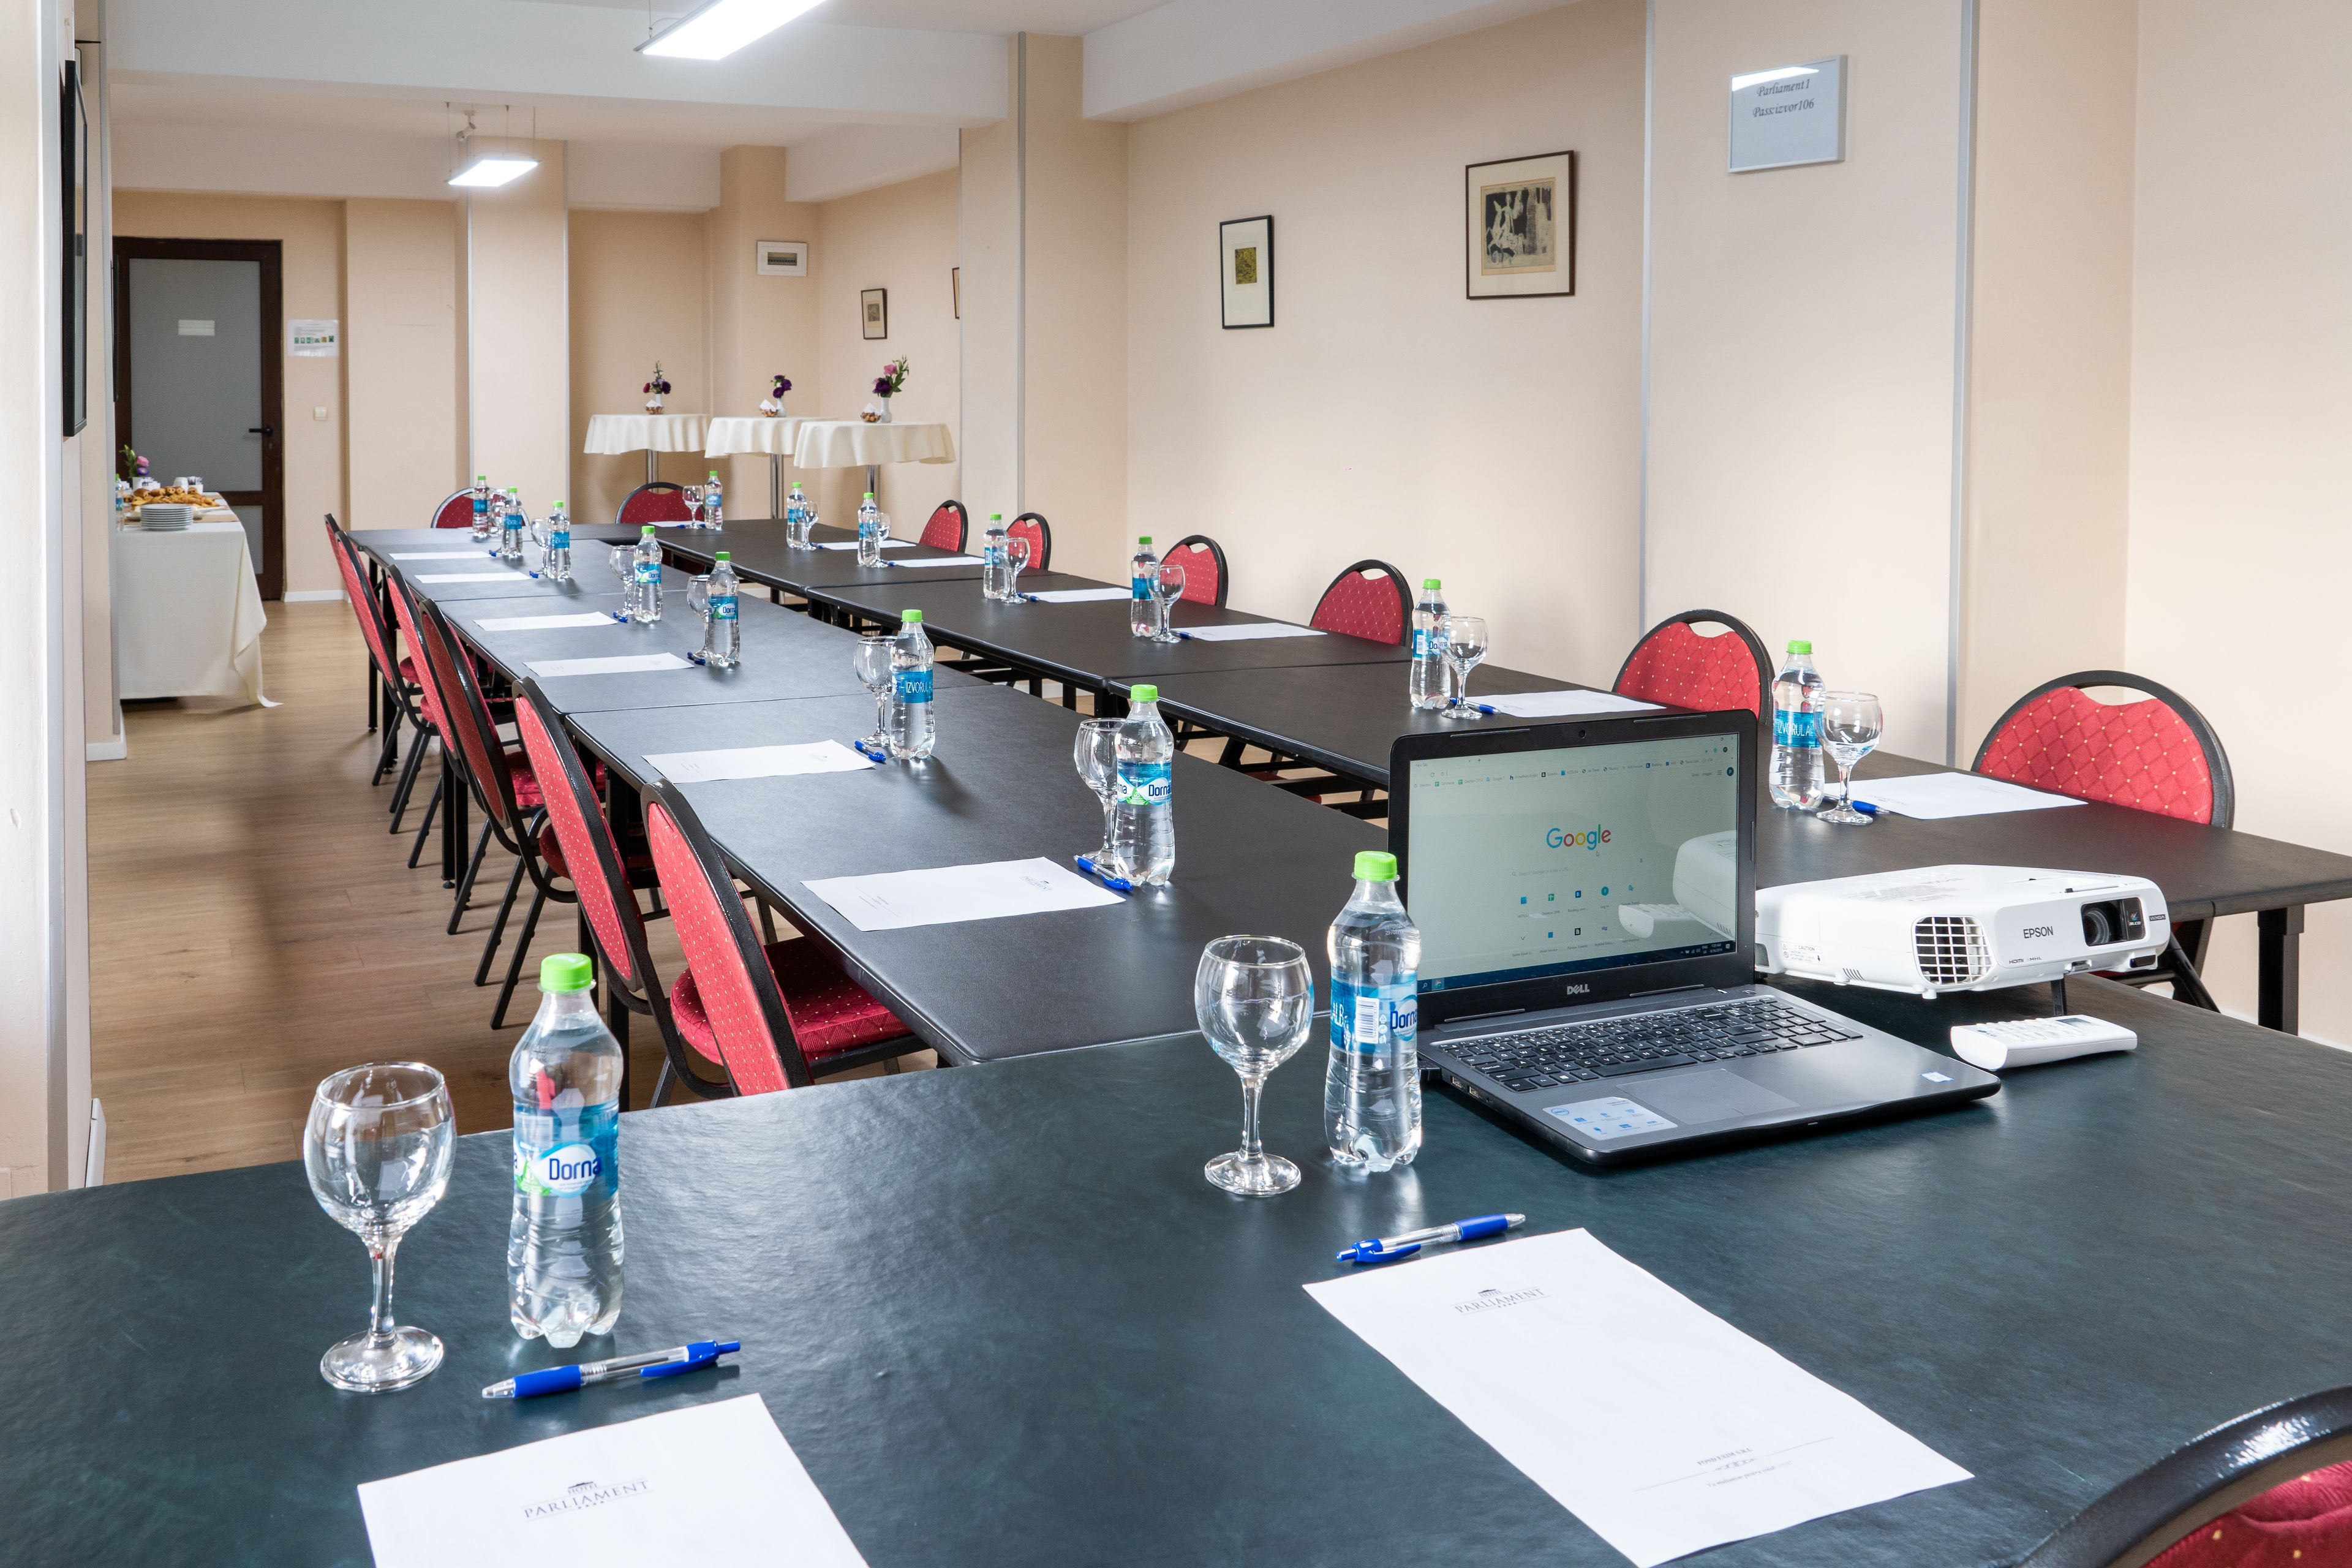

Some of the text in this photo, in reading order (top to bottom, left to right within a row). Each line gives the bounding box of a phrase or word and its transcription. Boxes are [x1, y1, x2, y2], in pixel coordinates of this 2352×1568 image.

[1757, 81, 1804, 96] Parliament
[1148, 784, 1170, 796] Dorna
[1547, 824, 1611, 850] Google
[2023, 925, 2054, 938] EPSON
[1567, 984, 1590, 995] DELL
[549, 1156, 602, 1180] Dorna
[1455, 1288, 1544, 1313] PARLIAMENT
[524, 1480, 649, 1518] PARLIAMENT
